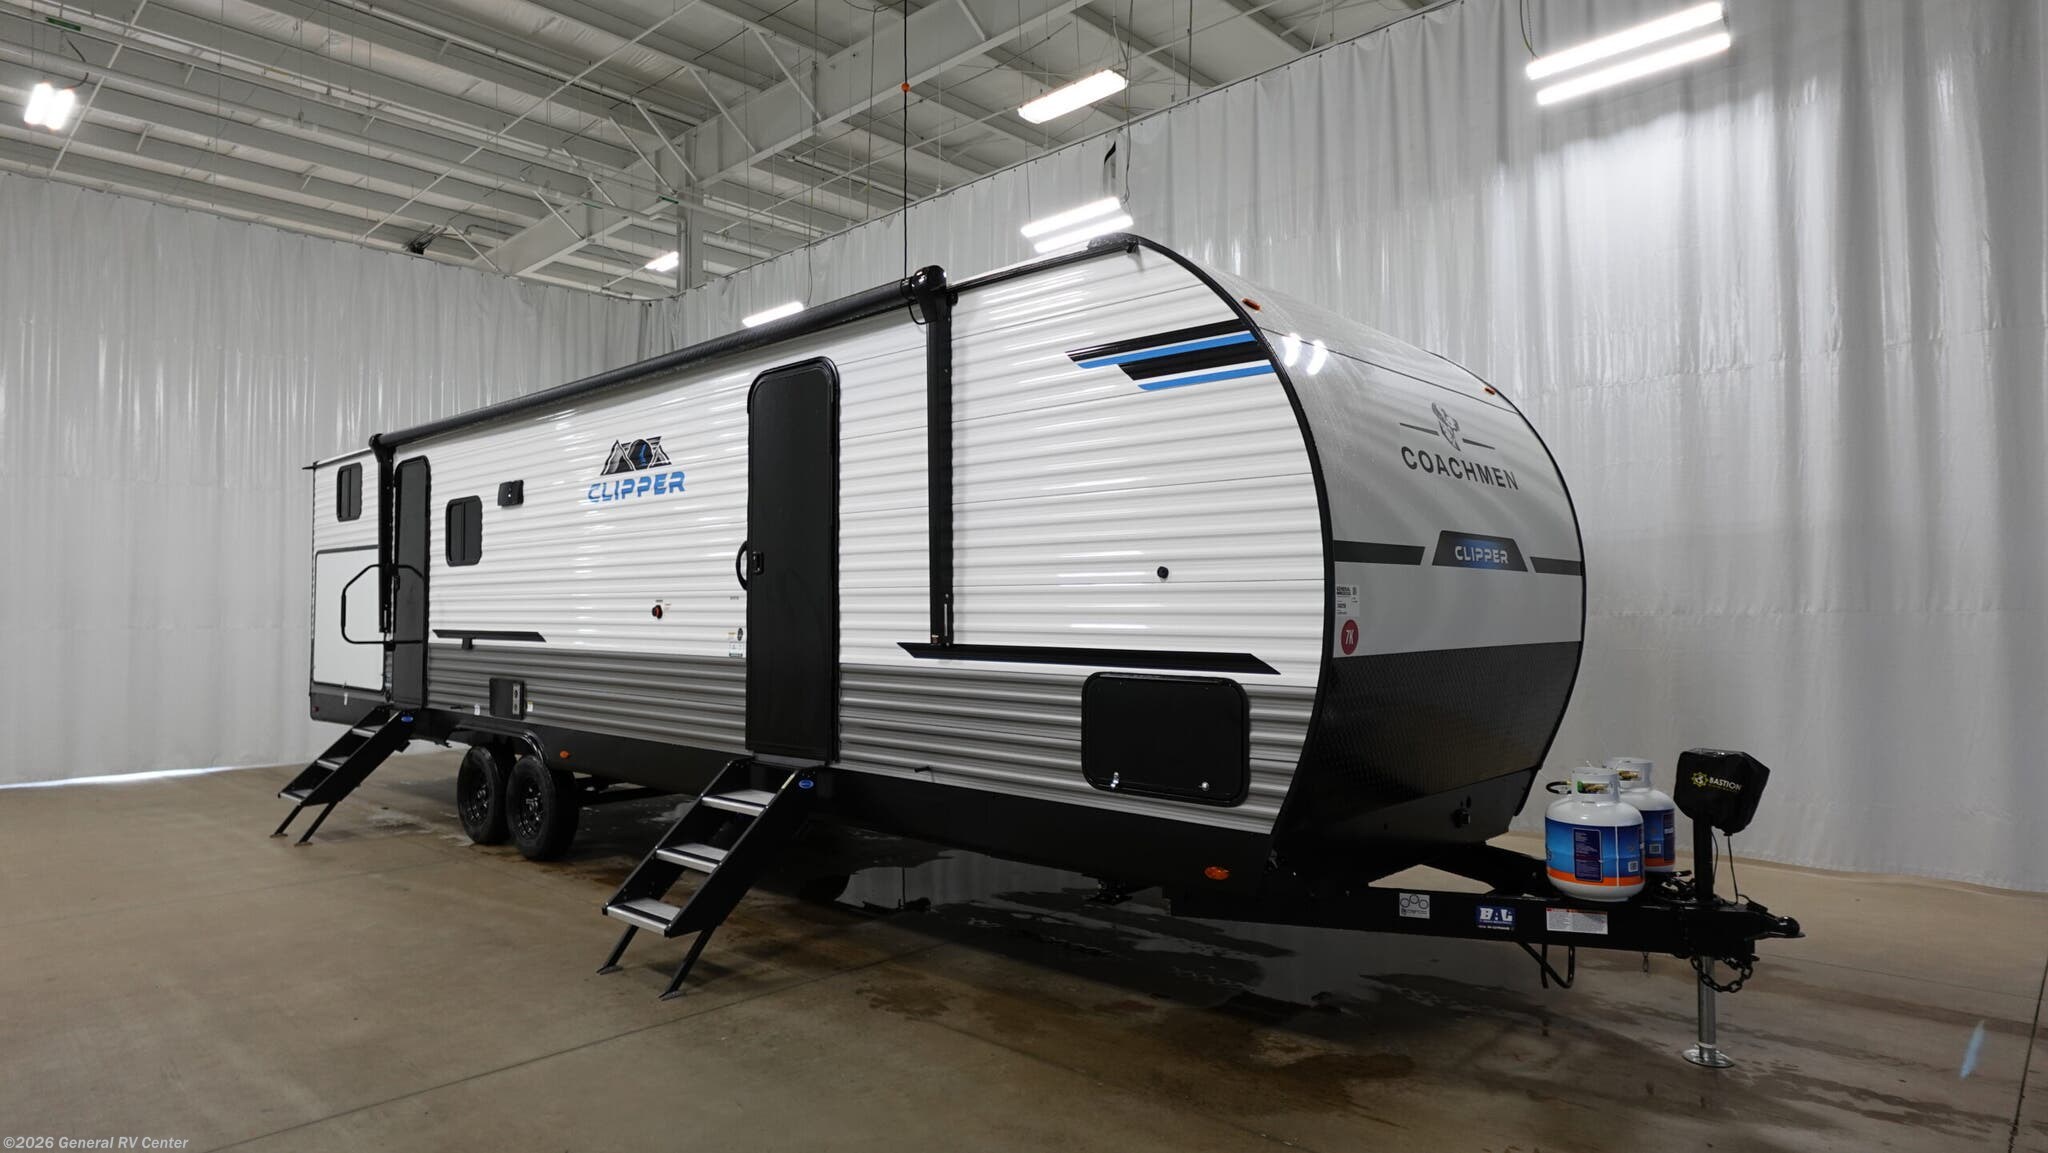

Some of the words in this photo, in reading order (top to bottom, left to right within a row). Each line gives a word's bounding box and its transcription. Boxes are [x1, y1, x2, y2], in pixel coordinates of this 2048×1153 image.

[1401, 446, 1519, 490] COACHMEN
[587, 471, 686, 502] CLIPPER
[1454, 545, 1509, 564] CLIPPER
[1709, 776, 1742, 791] BASTION
